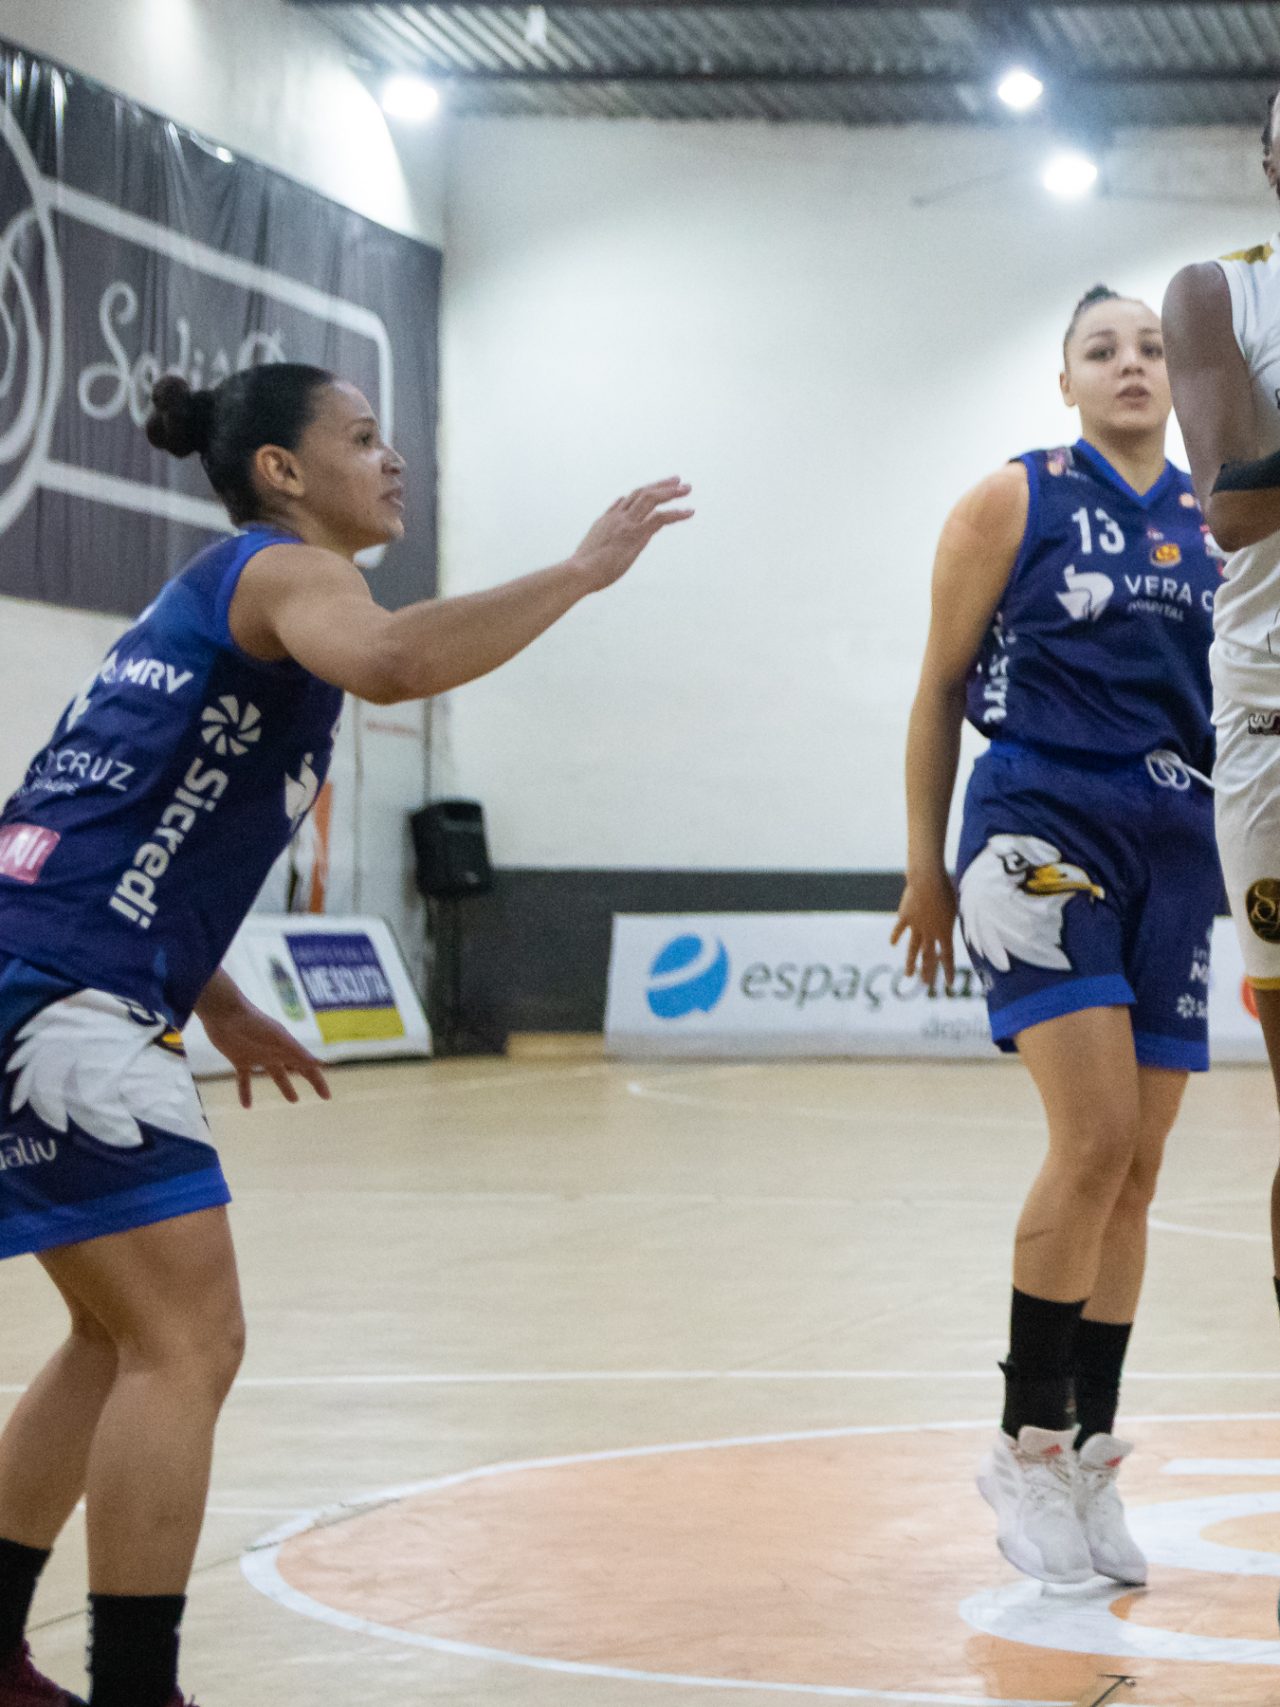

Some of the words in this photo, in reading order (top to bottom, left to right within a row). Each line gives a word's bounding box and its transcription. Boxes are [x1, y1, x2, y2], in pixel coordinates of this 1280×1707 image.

[1072, 507, 1126, 555] 13
[1124, 573, 1193, 607] VERA
[121, 657, 194, 695] MRV
[56, 749, 136, 792] CRUZ
[109, 757, 229, 930] Sicredi
